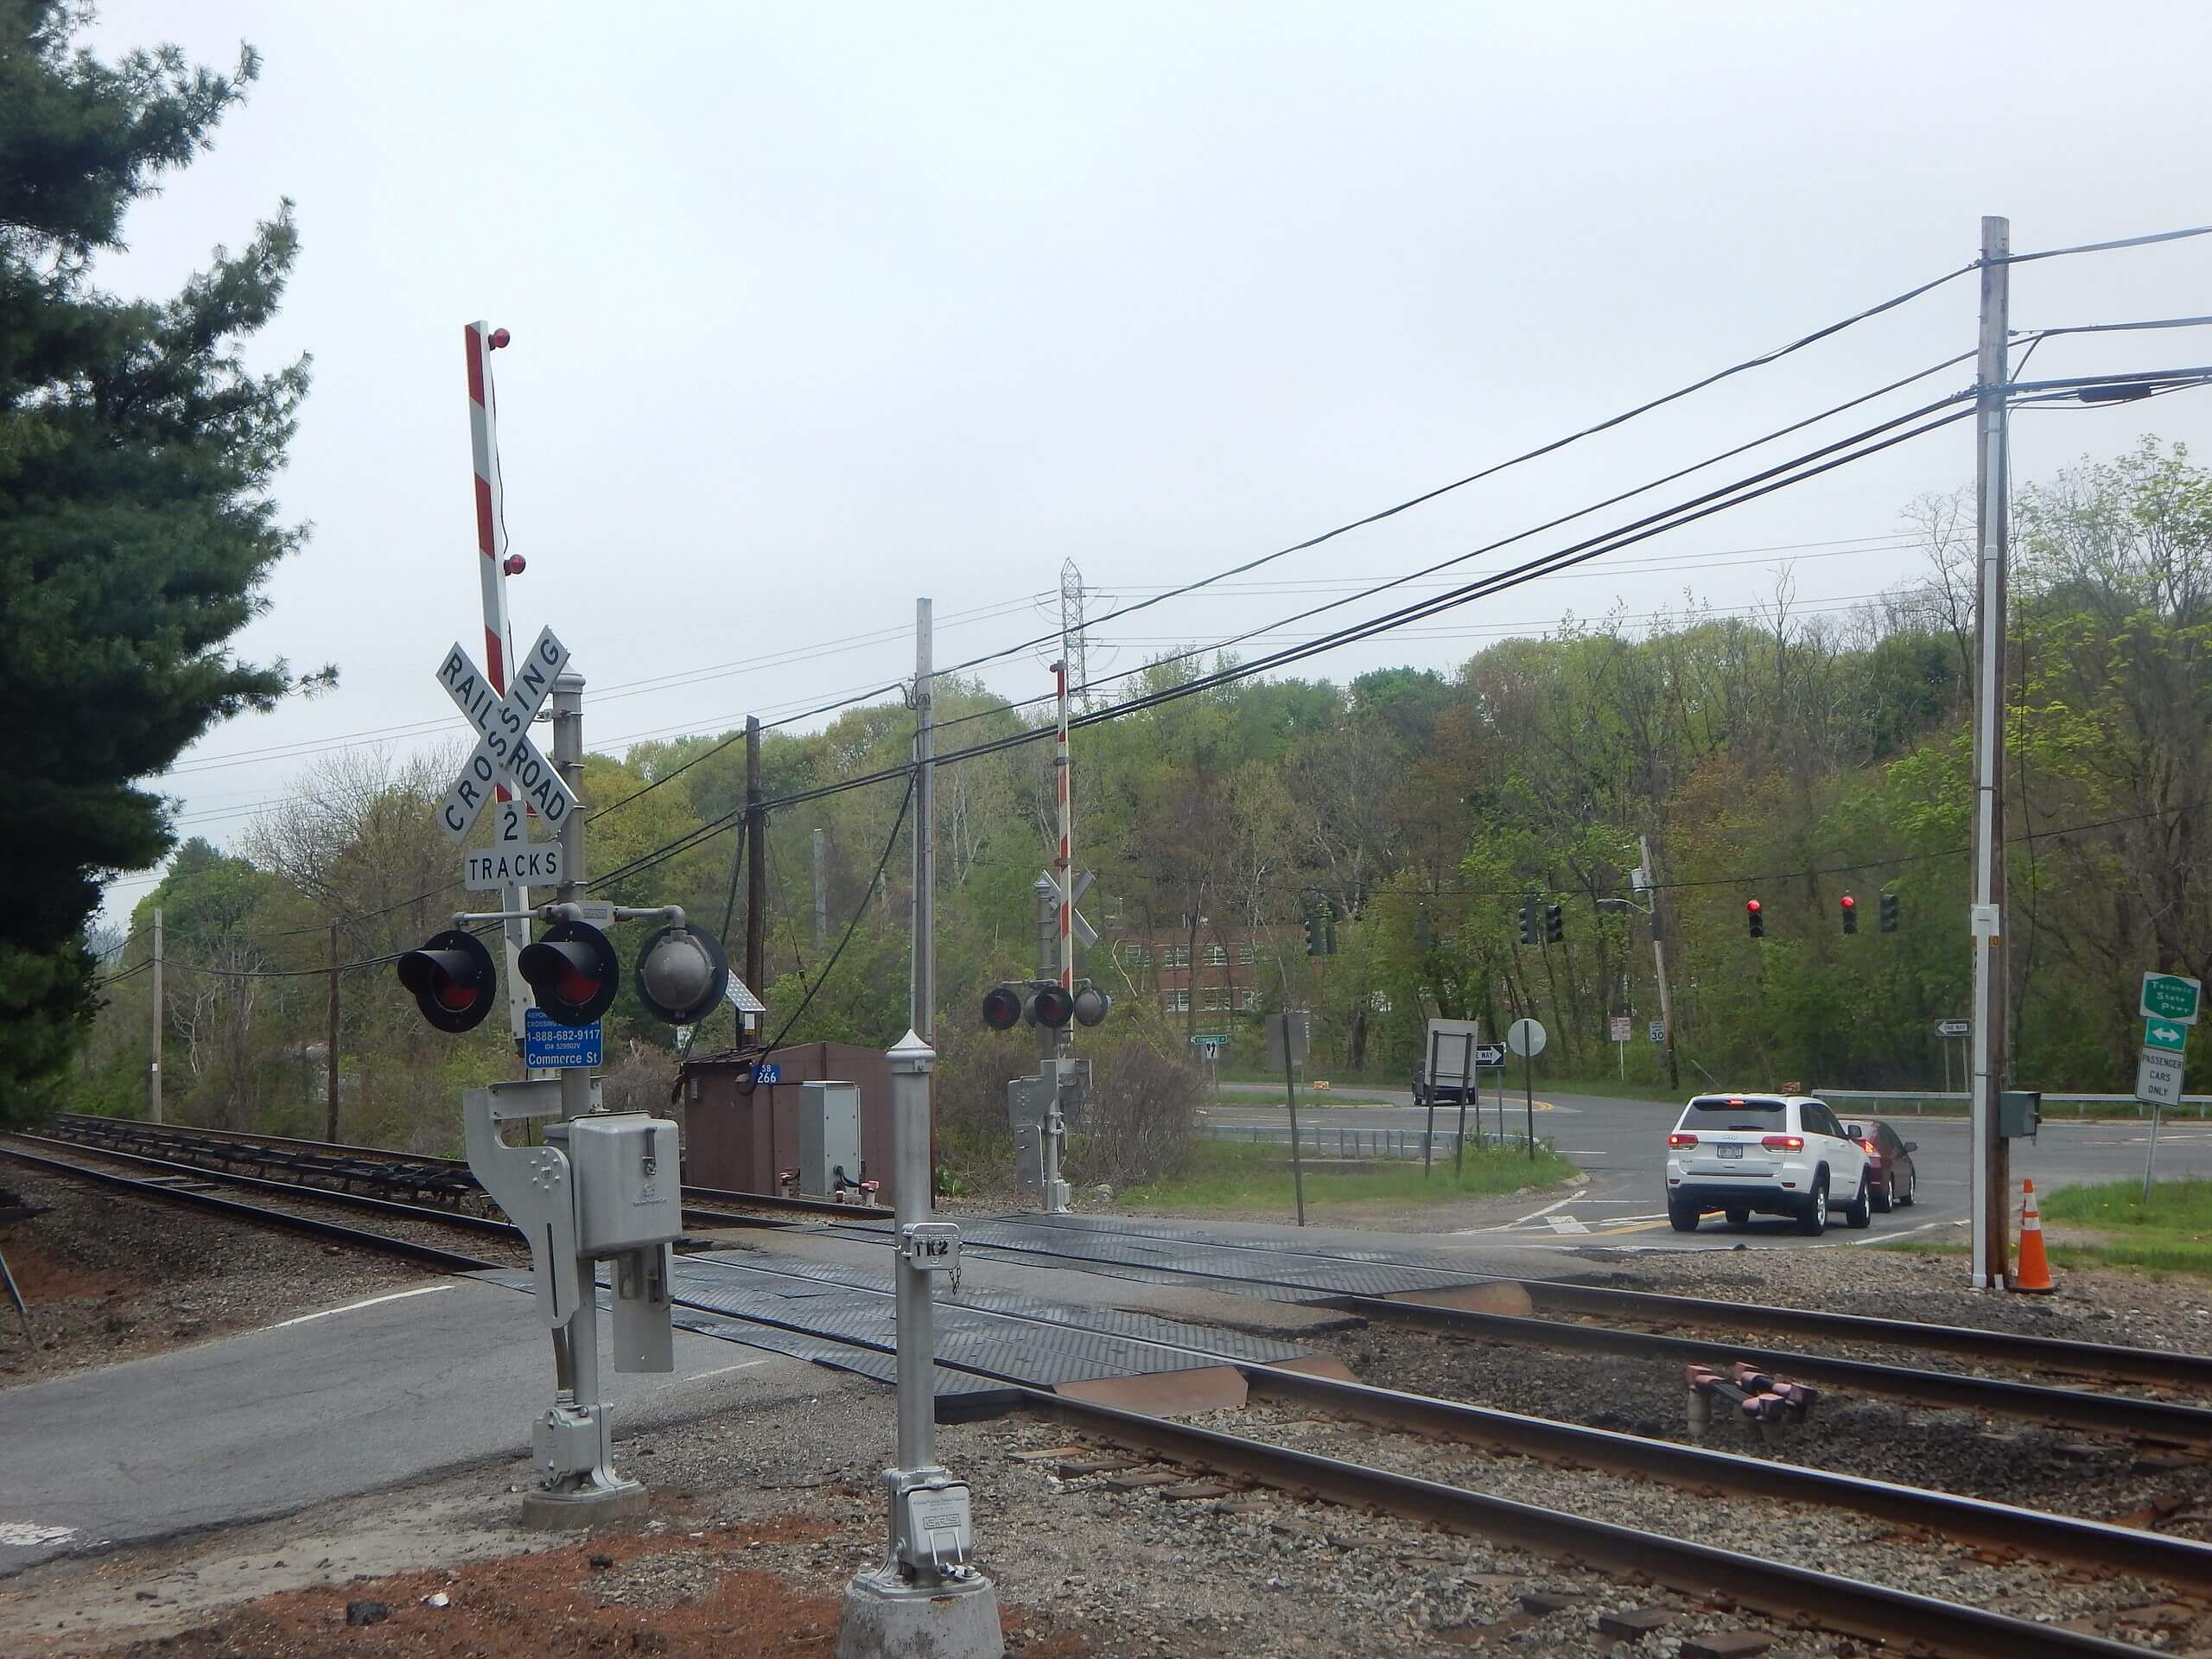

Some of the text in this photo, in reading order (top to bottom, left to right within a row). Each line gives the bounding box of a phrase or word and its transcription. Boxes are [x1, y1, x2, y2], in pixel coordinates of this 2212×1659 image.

[445, 639, 559, 830] CROSSING
[504, 810, 518, 841] 2
[469, 852, 557, 880] TRACKS
[527, 1029, 601, 1042] 1-888-682-9117
[528, 1051, 598, 1065] Commerce St
[2142, 1053, 2182, 1070] PASSENGER
[761, 1064, 772, 1072] SB
[757, 1071, 777, 1084] 266
[2149, 1070, 2171, 1082] CARS
[2148, 1084, 2168, 1096] ONLY
